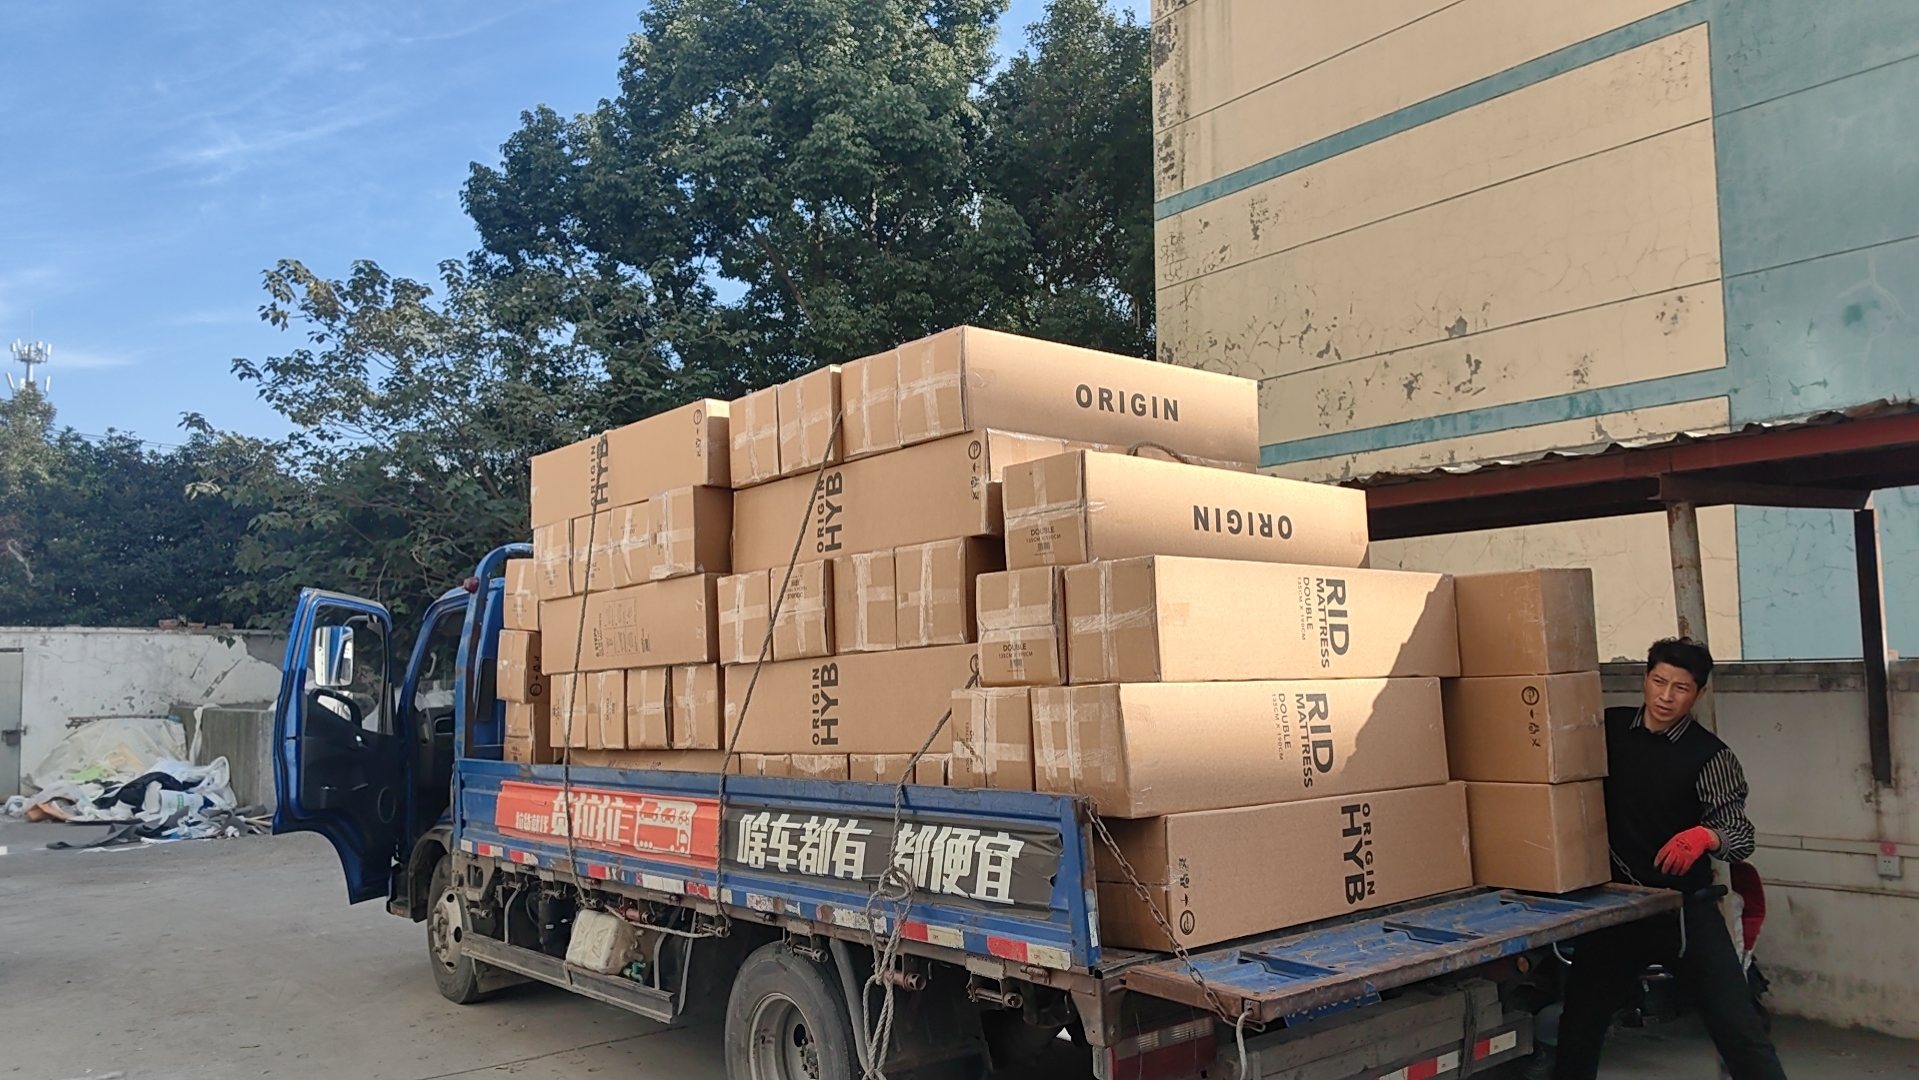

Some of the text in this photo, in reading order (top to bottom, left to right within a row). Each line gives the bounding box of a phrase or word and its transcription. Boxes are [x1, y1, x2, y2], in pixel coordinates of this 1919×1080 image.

[1075, 383, 1179, 422] ORIGIN
[817, 479, 825, 553] ORIGIN
[825, 471, 843, 552] HYB
[1030, 525, 1055, 536] DOUBLE
[1193, 504, 1293, 540] ORIGIN
[1303, 577, 1314, 630] DOUBLE
[1315, 577, 1330, 668] MATTRESS
[1325, 578, 1350, 656] RID
[1003, 643, 1027, 652] DOUBLE
[812, 668, 820, 746] ORIGIN
[820, 662, 839, 746] HYB
[1272, 693, 1280, 721] 135CM
[1278, 693, 1291, 749] DOUBLE
[1295, 693, 1313, 788] MATTRESS
[1305, 693, 1334, 774] RID
[736, 811, 1025, 905] 啥车都有 都便宜
[1341, 803, 1366, 905] HYB
[1362, 803, 1376, 896] ORIGIN
